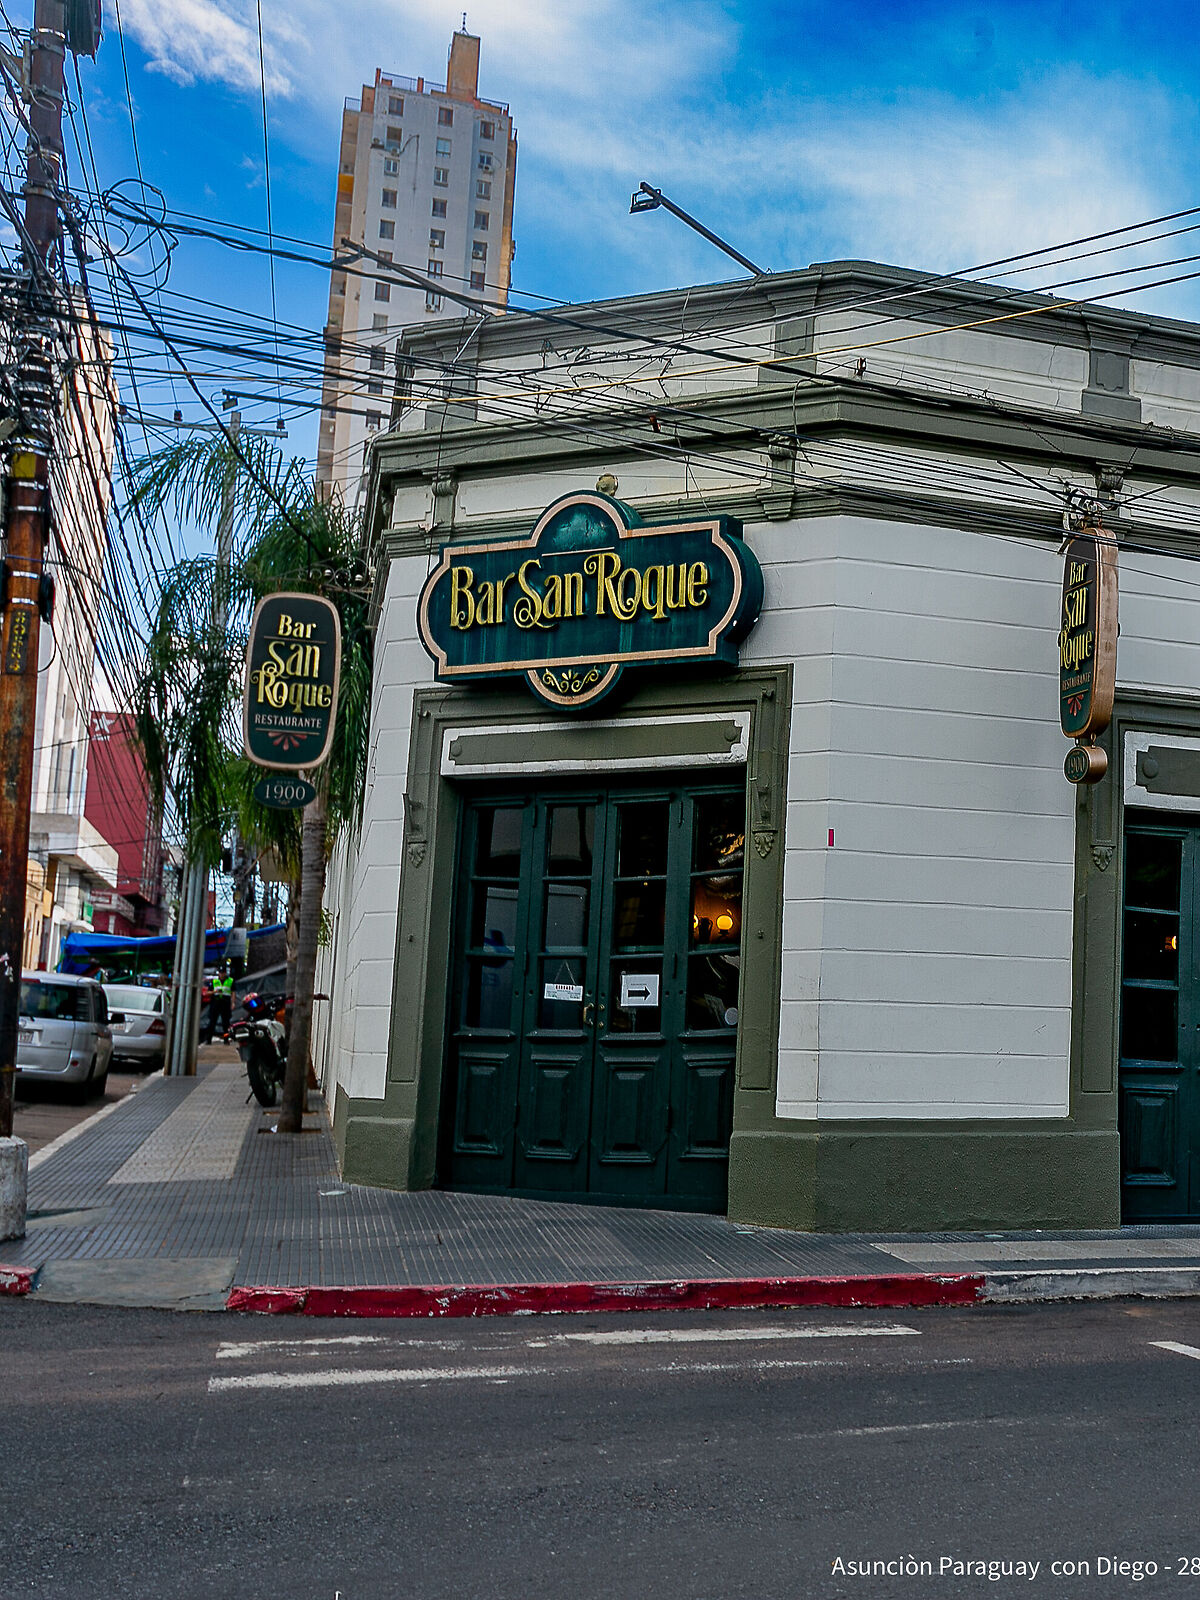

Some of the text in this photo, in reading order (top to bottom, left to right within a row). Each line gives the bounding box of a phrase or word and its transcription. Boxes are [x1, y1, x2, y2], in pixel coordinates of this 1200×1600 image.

[450, 552, 708, 630] Bar San Roque
[1069, 561, 1087, 586] Bar
[278, 613, 317, 639] Bar
[1063, 586, 1087, 631] San
[261, 640, 320, 679] San
[1060, 629, 1093, 671] Roque
[250, 669, 332, 714] Roque
[254, 713, 322, 729] RESTAURANTE
[265, 783, 306, 801] 1900
